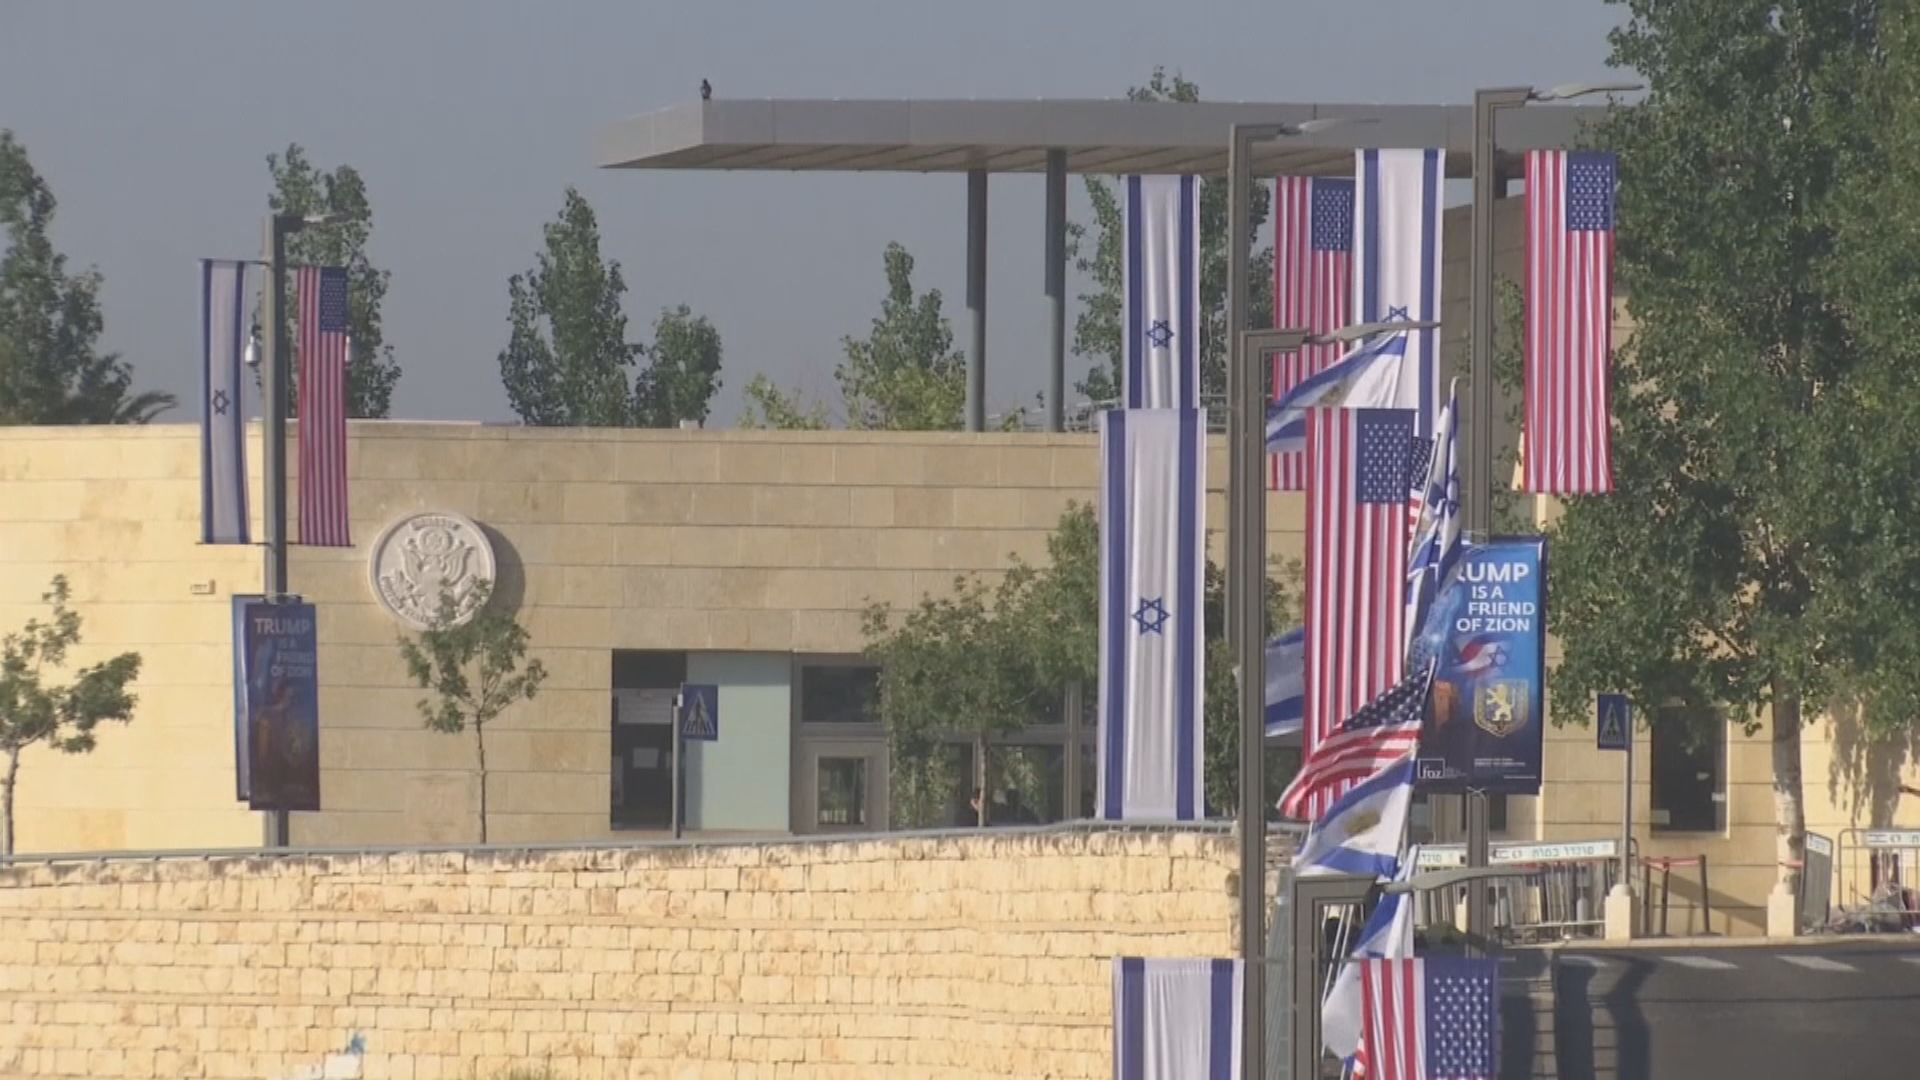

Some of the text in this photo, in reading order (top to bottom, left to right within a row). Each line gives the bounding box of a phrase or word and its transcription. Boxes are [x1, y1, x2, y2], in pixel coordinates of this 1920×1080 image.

[1472, 585, 1505, 599] IS A
[1468, 601, 1536, 616] FRIEND
[255, 618, 310, 634] TRUMP
[1456, 618, 1530, 632] OF ZION
